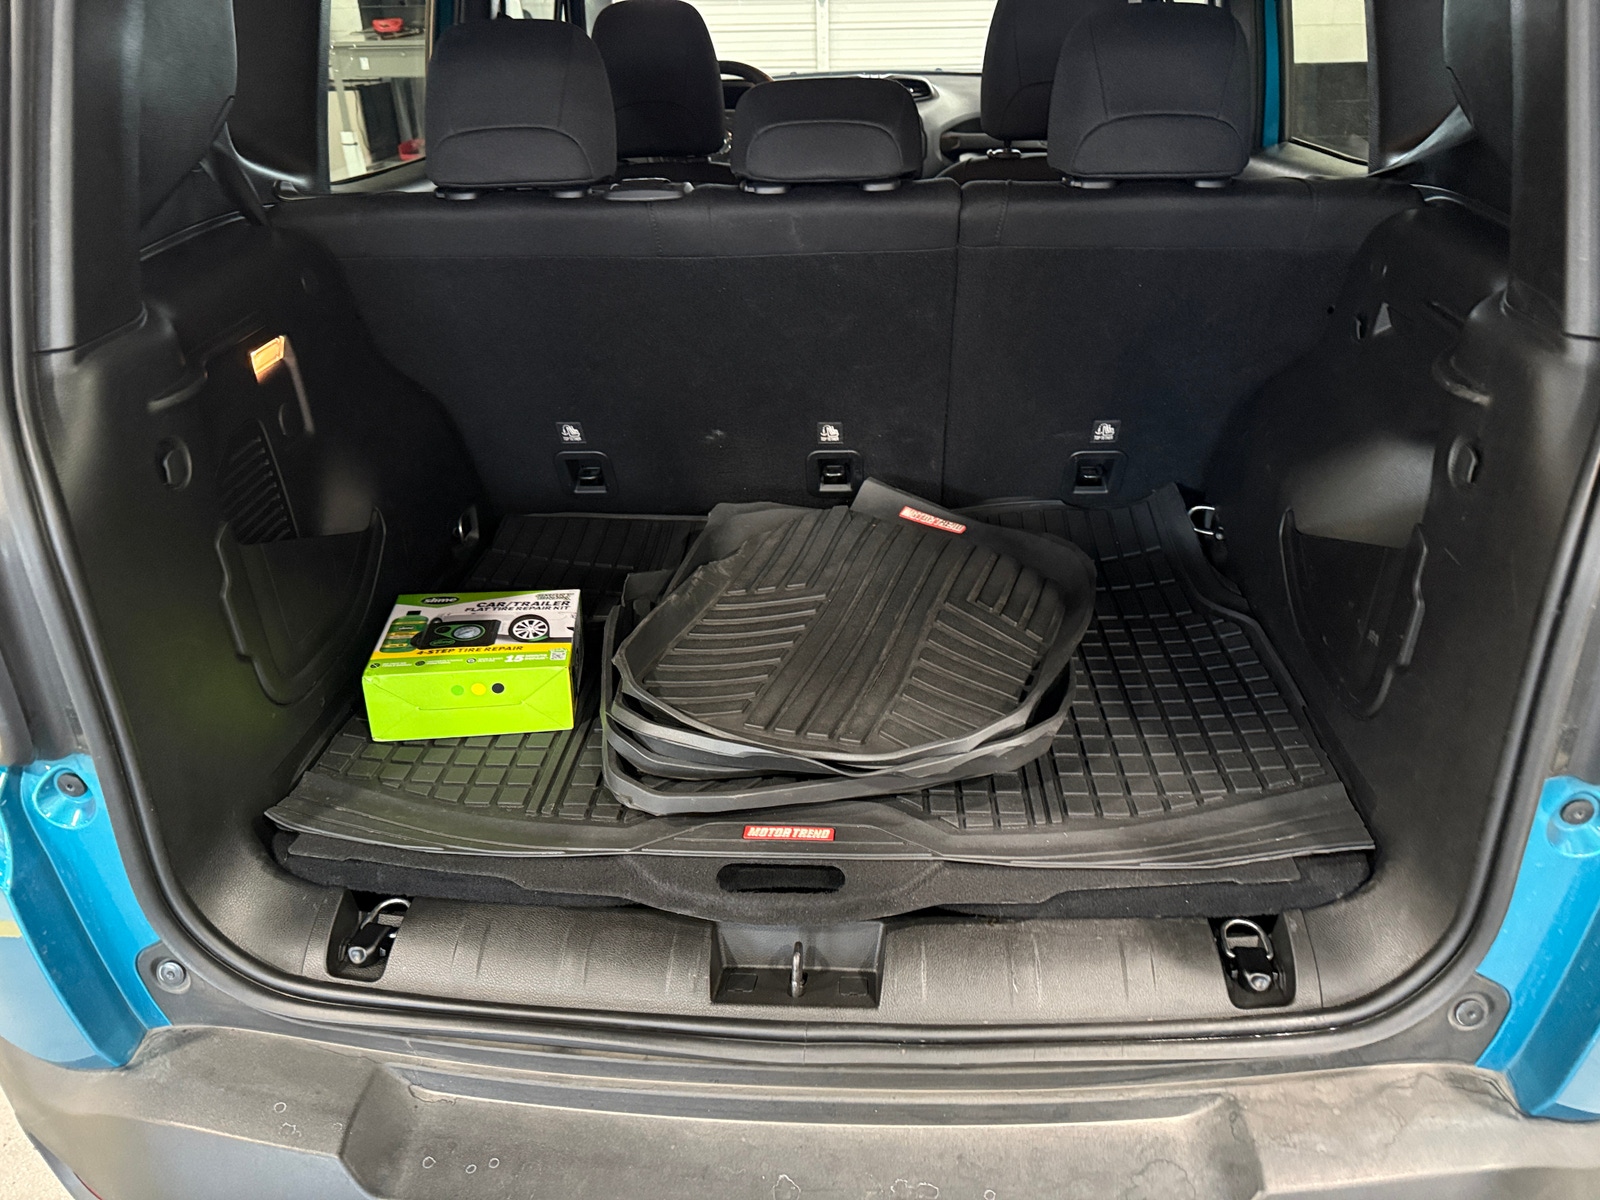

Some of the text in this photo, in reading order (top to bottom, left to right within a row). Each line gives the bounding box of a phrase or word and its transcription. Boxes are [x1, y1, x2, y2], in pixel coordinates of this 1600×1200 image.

[476, 600, 571, 608] CAR/TRAILER
[504, 654, 525, 663] 15
[747, 827, 830, 838] MOTOR TREND
